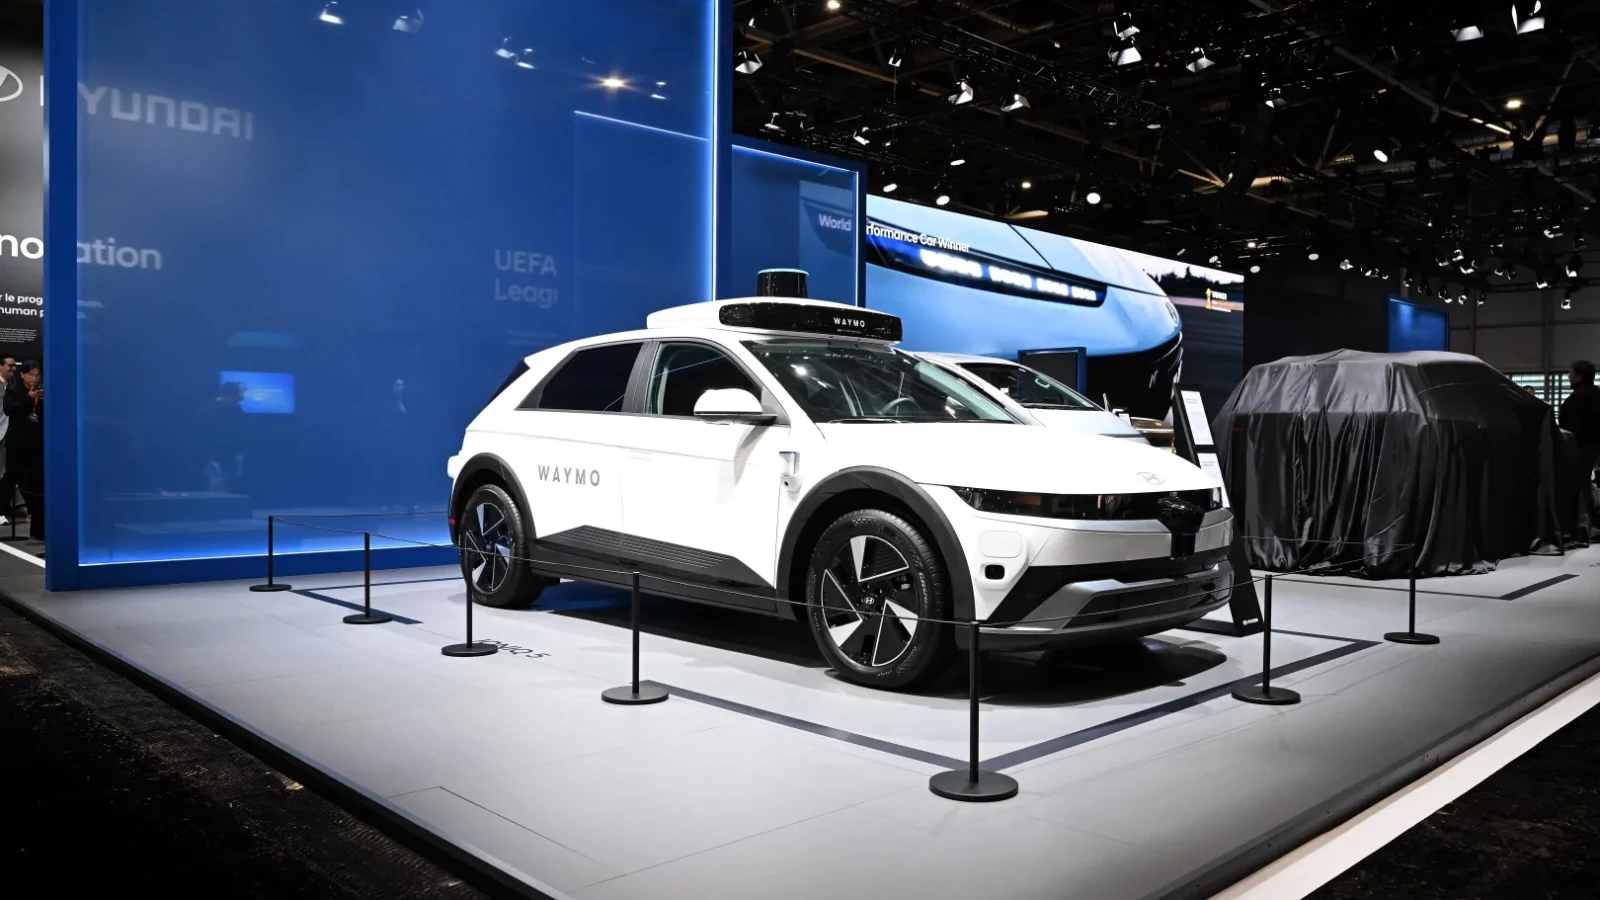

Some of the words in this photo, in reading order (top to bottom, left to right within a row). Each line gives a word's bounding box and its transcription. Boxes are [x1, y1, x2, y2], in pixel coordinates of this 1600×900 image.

[818, 213, 852, 231] World
[866, 223, 917, 244] rformance
[919, 233, 936, 247] Car
[938, 236, 970, 252] Winner
[494, 248, 557, 276] UEFA
[5, 293, 15, 302] le
[18, 295, 43, 306] prog
[495, 278, 558, 309] Leag
[833, 317, 866, 328] WAYMO
[537, 464, 601, 487] WAYMO
